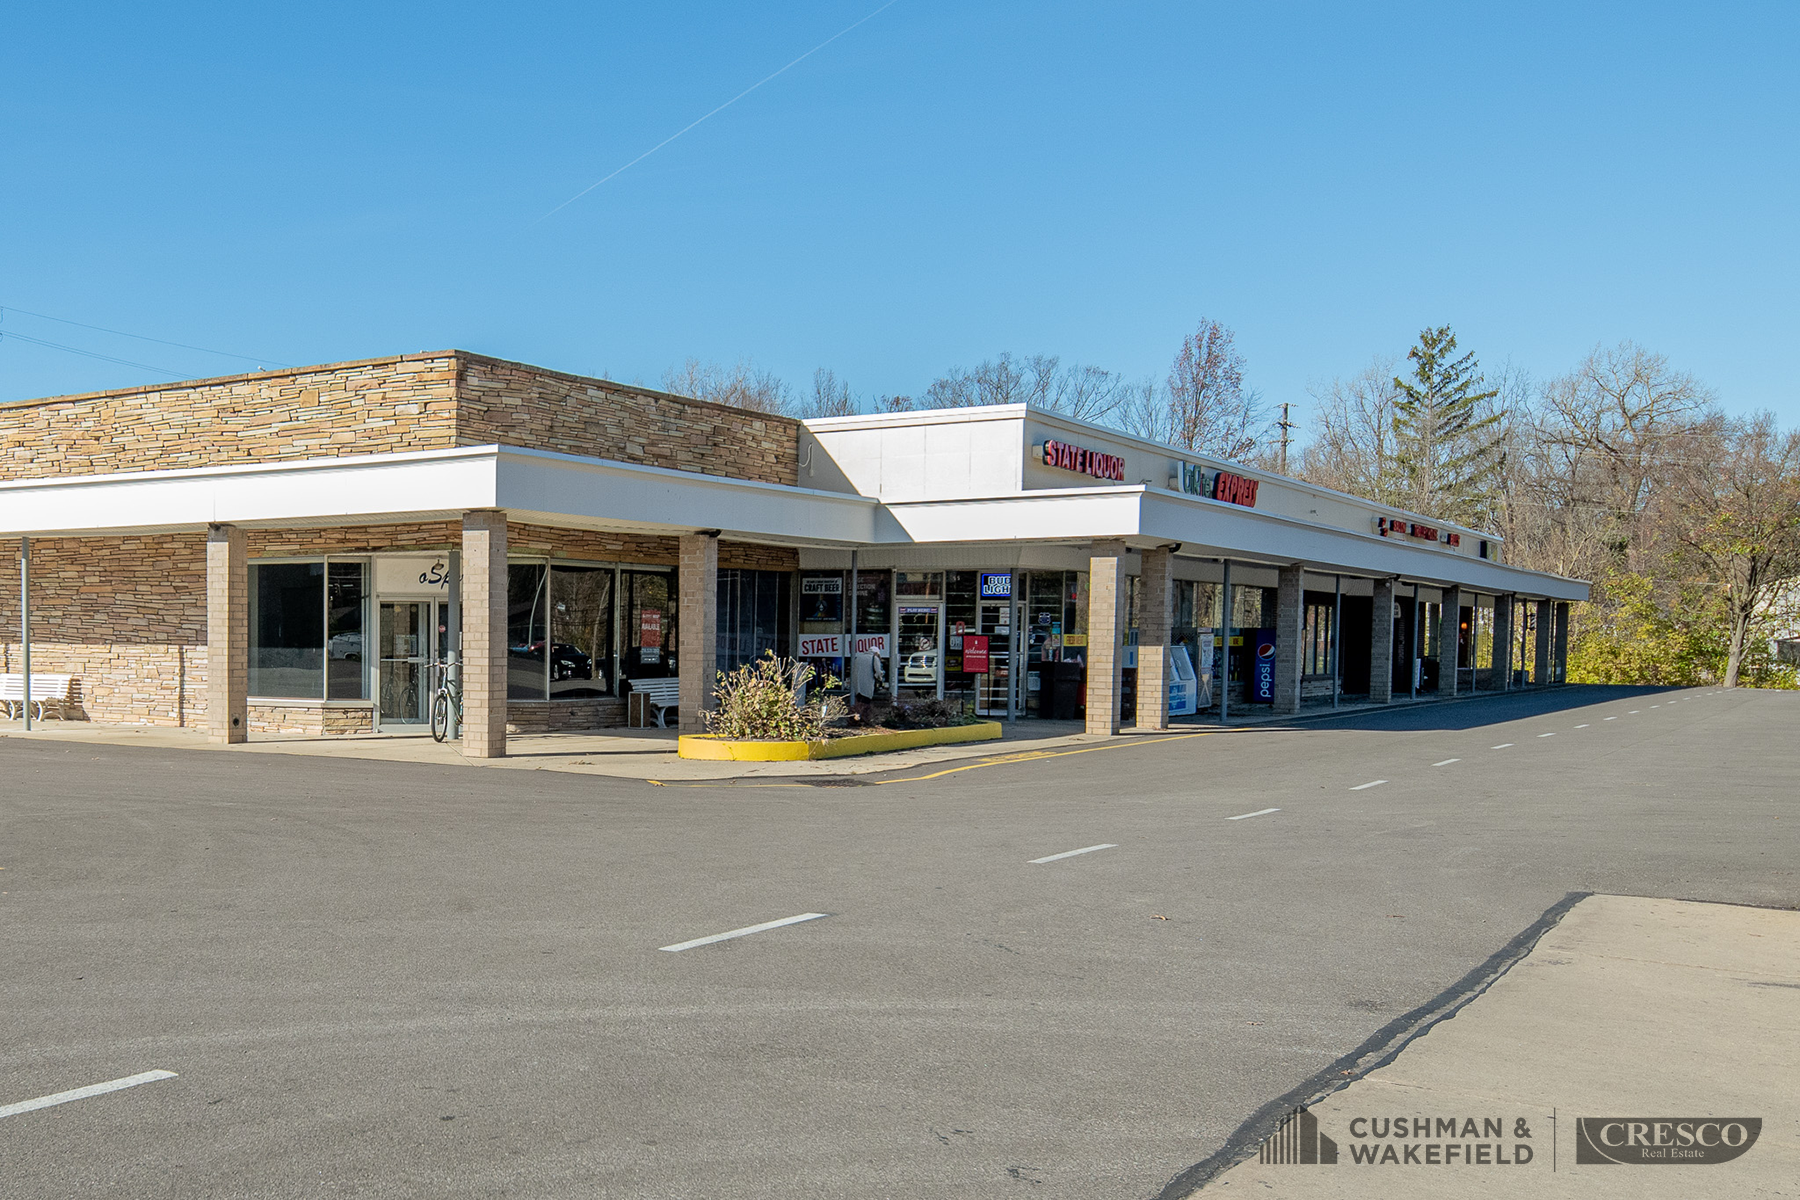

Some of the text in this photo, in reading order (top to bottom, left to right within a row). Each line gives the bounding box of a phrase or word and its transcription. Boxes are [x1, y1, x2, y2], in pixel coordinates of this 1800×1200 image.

[1044, 440, 1125, 481] STATE LIQUOR
[1216, 472, 1259, 508] EXPRESS
[804, 583, 840, 592] CRAFT BEER
[983, 584, 1011, 595] LIGH
[801, 637, 839, 655] STATE
[1259, 662, 1273, 698] pepsi
